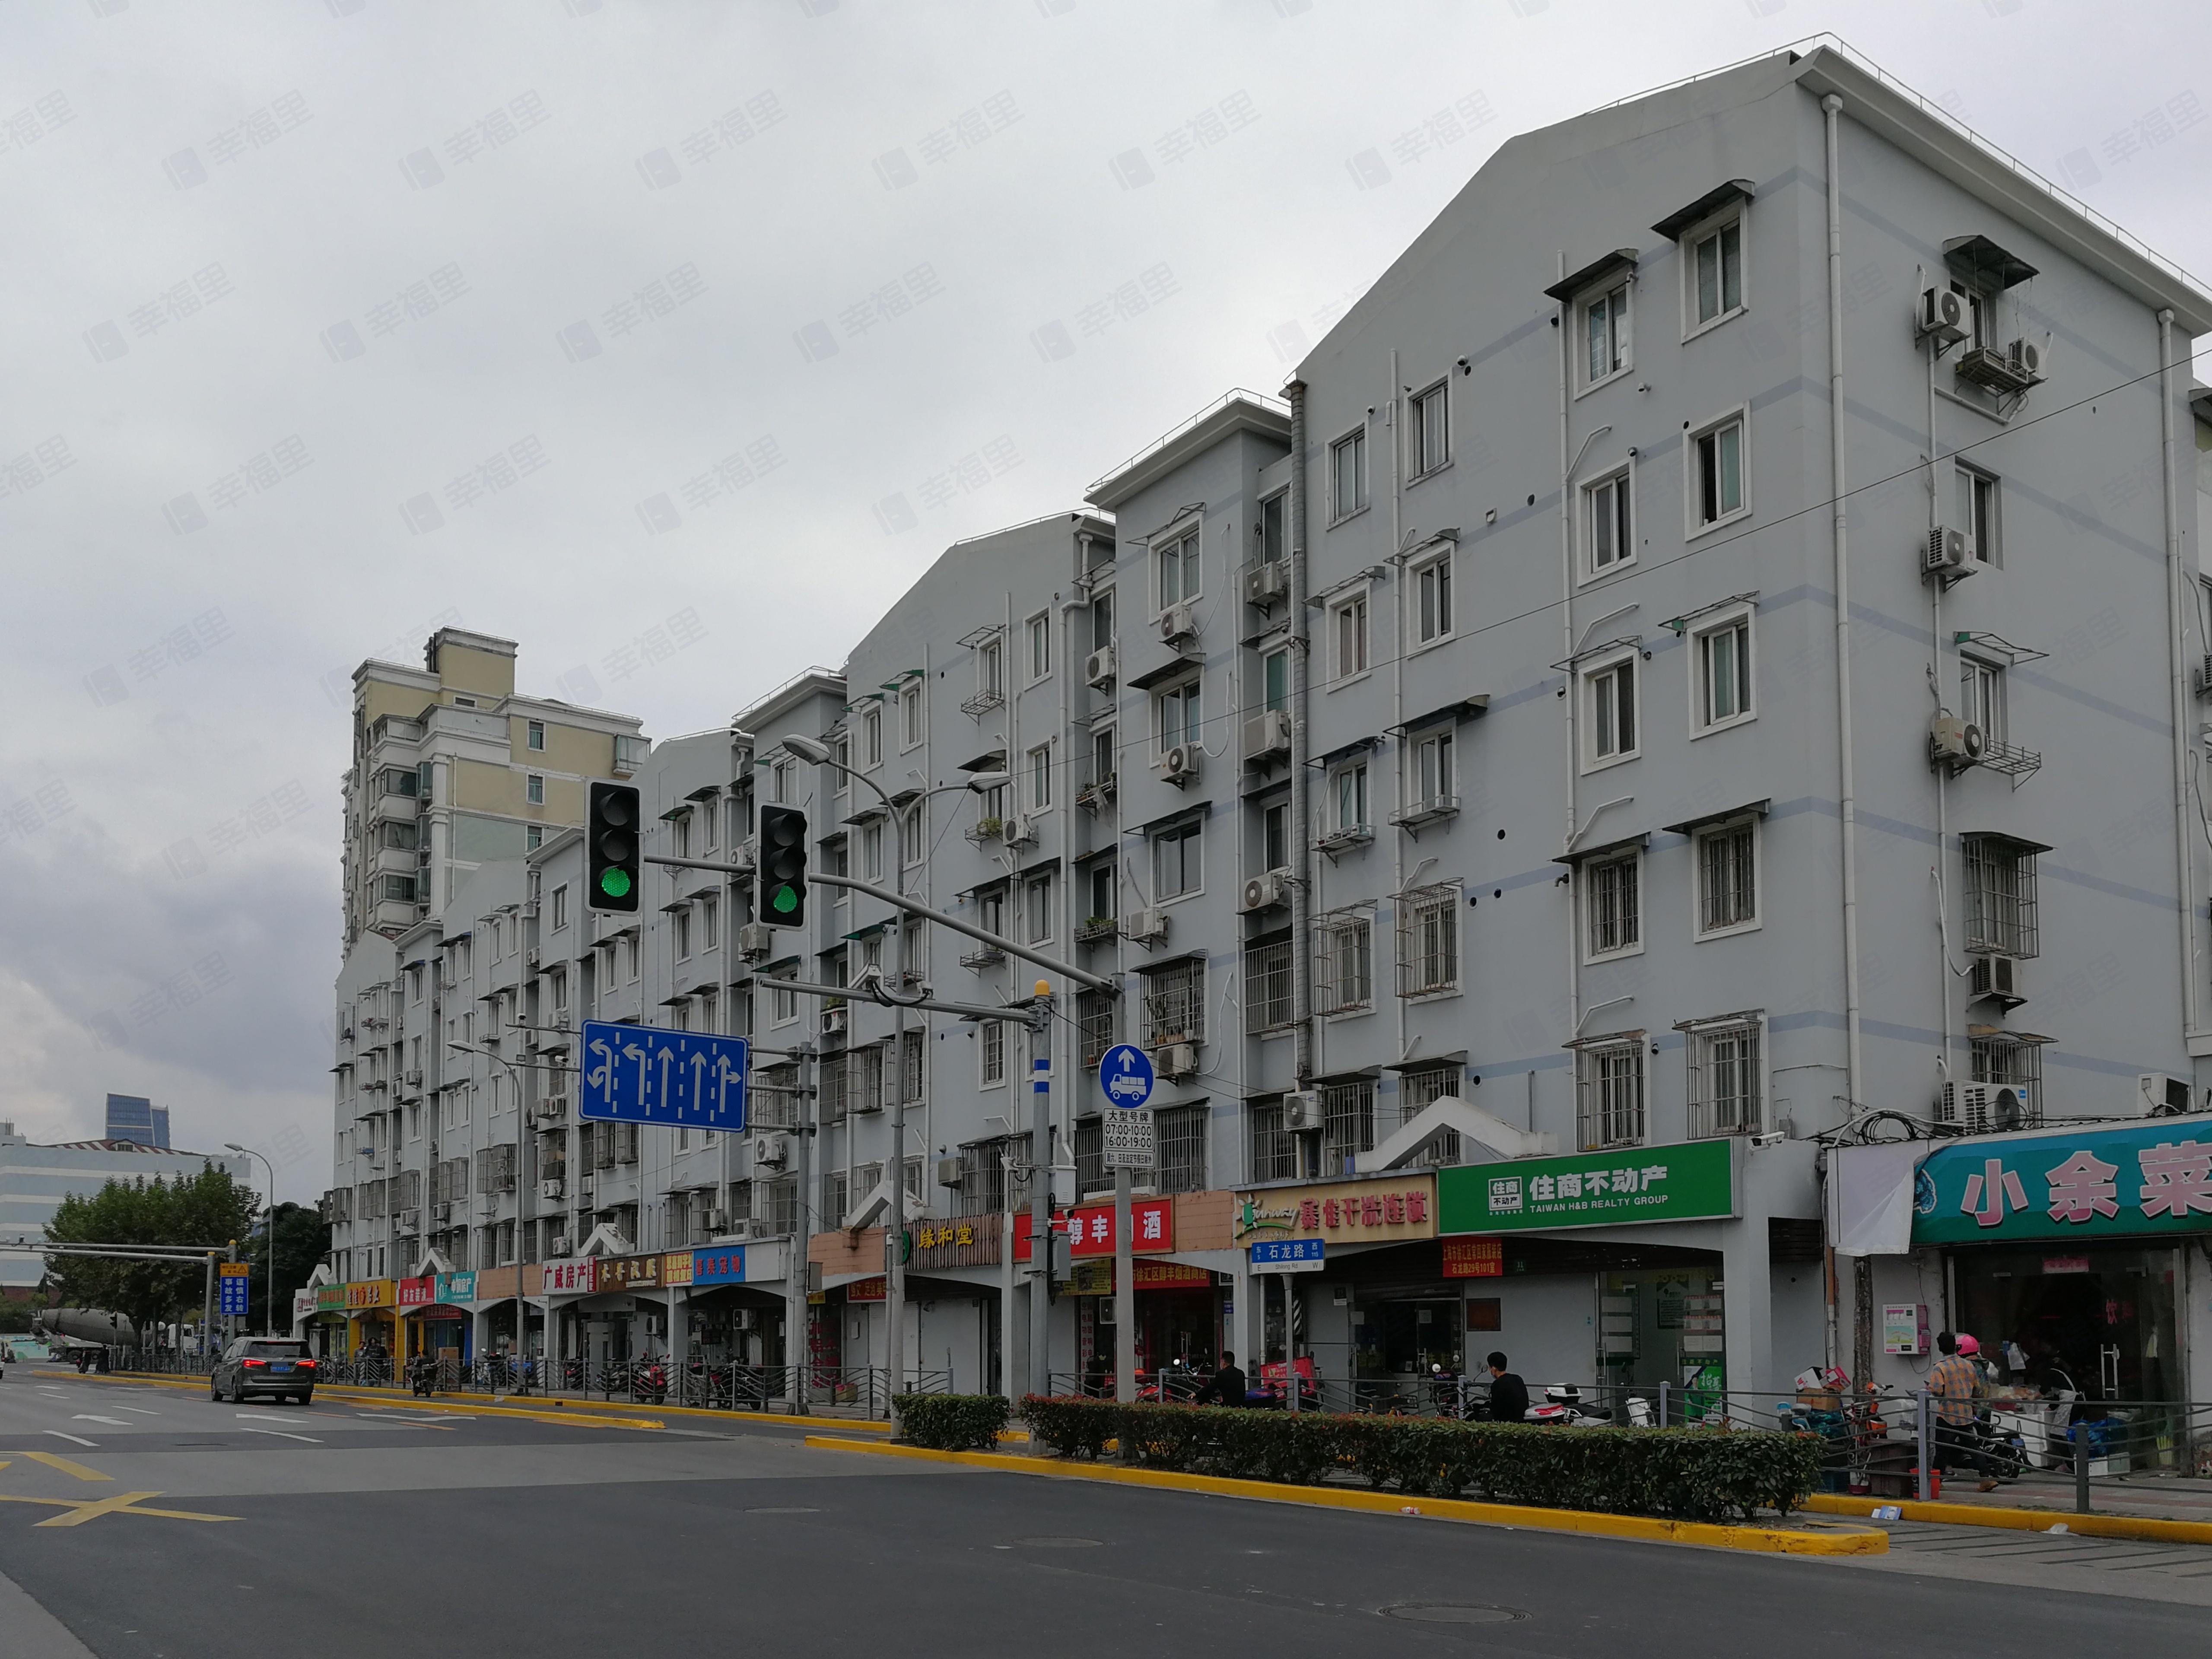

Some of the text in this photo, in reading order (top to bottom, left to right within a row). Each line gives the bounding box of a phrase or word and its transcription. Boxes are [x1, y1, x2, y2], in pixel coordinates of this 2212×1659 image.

[1109, 1110, 1149, 1123] 大型号牌
[1492, 1181, 1518, 1194] 住商
[1529, 1165, 1668, 1201] 住商不动产
[1494, 1197, 1517, 1206] 不动产
[1530, 1195, 1669, 1213] TAIWAN H&B REALTY GROUP
[1067, 1211, 1161, 1245] 醇丰酒
[919, 1224, 973, 1249] 缘和堂
[1269, 1244, 1305, 1259] 石龙路
[1312, 1242, 1318, 1250] 西
[1452, 1262, 1495, 1274] 石龙路29号101室
[544, 1263, 586, 1290] 广威房产
[225, 1278, 233, 1312] 事故多发
